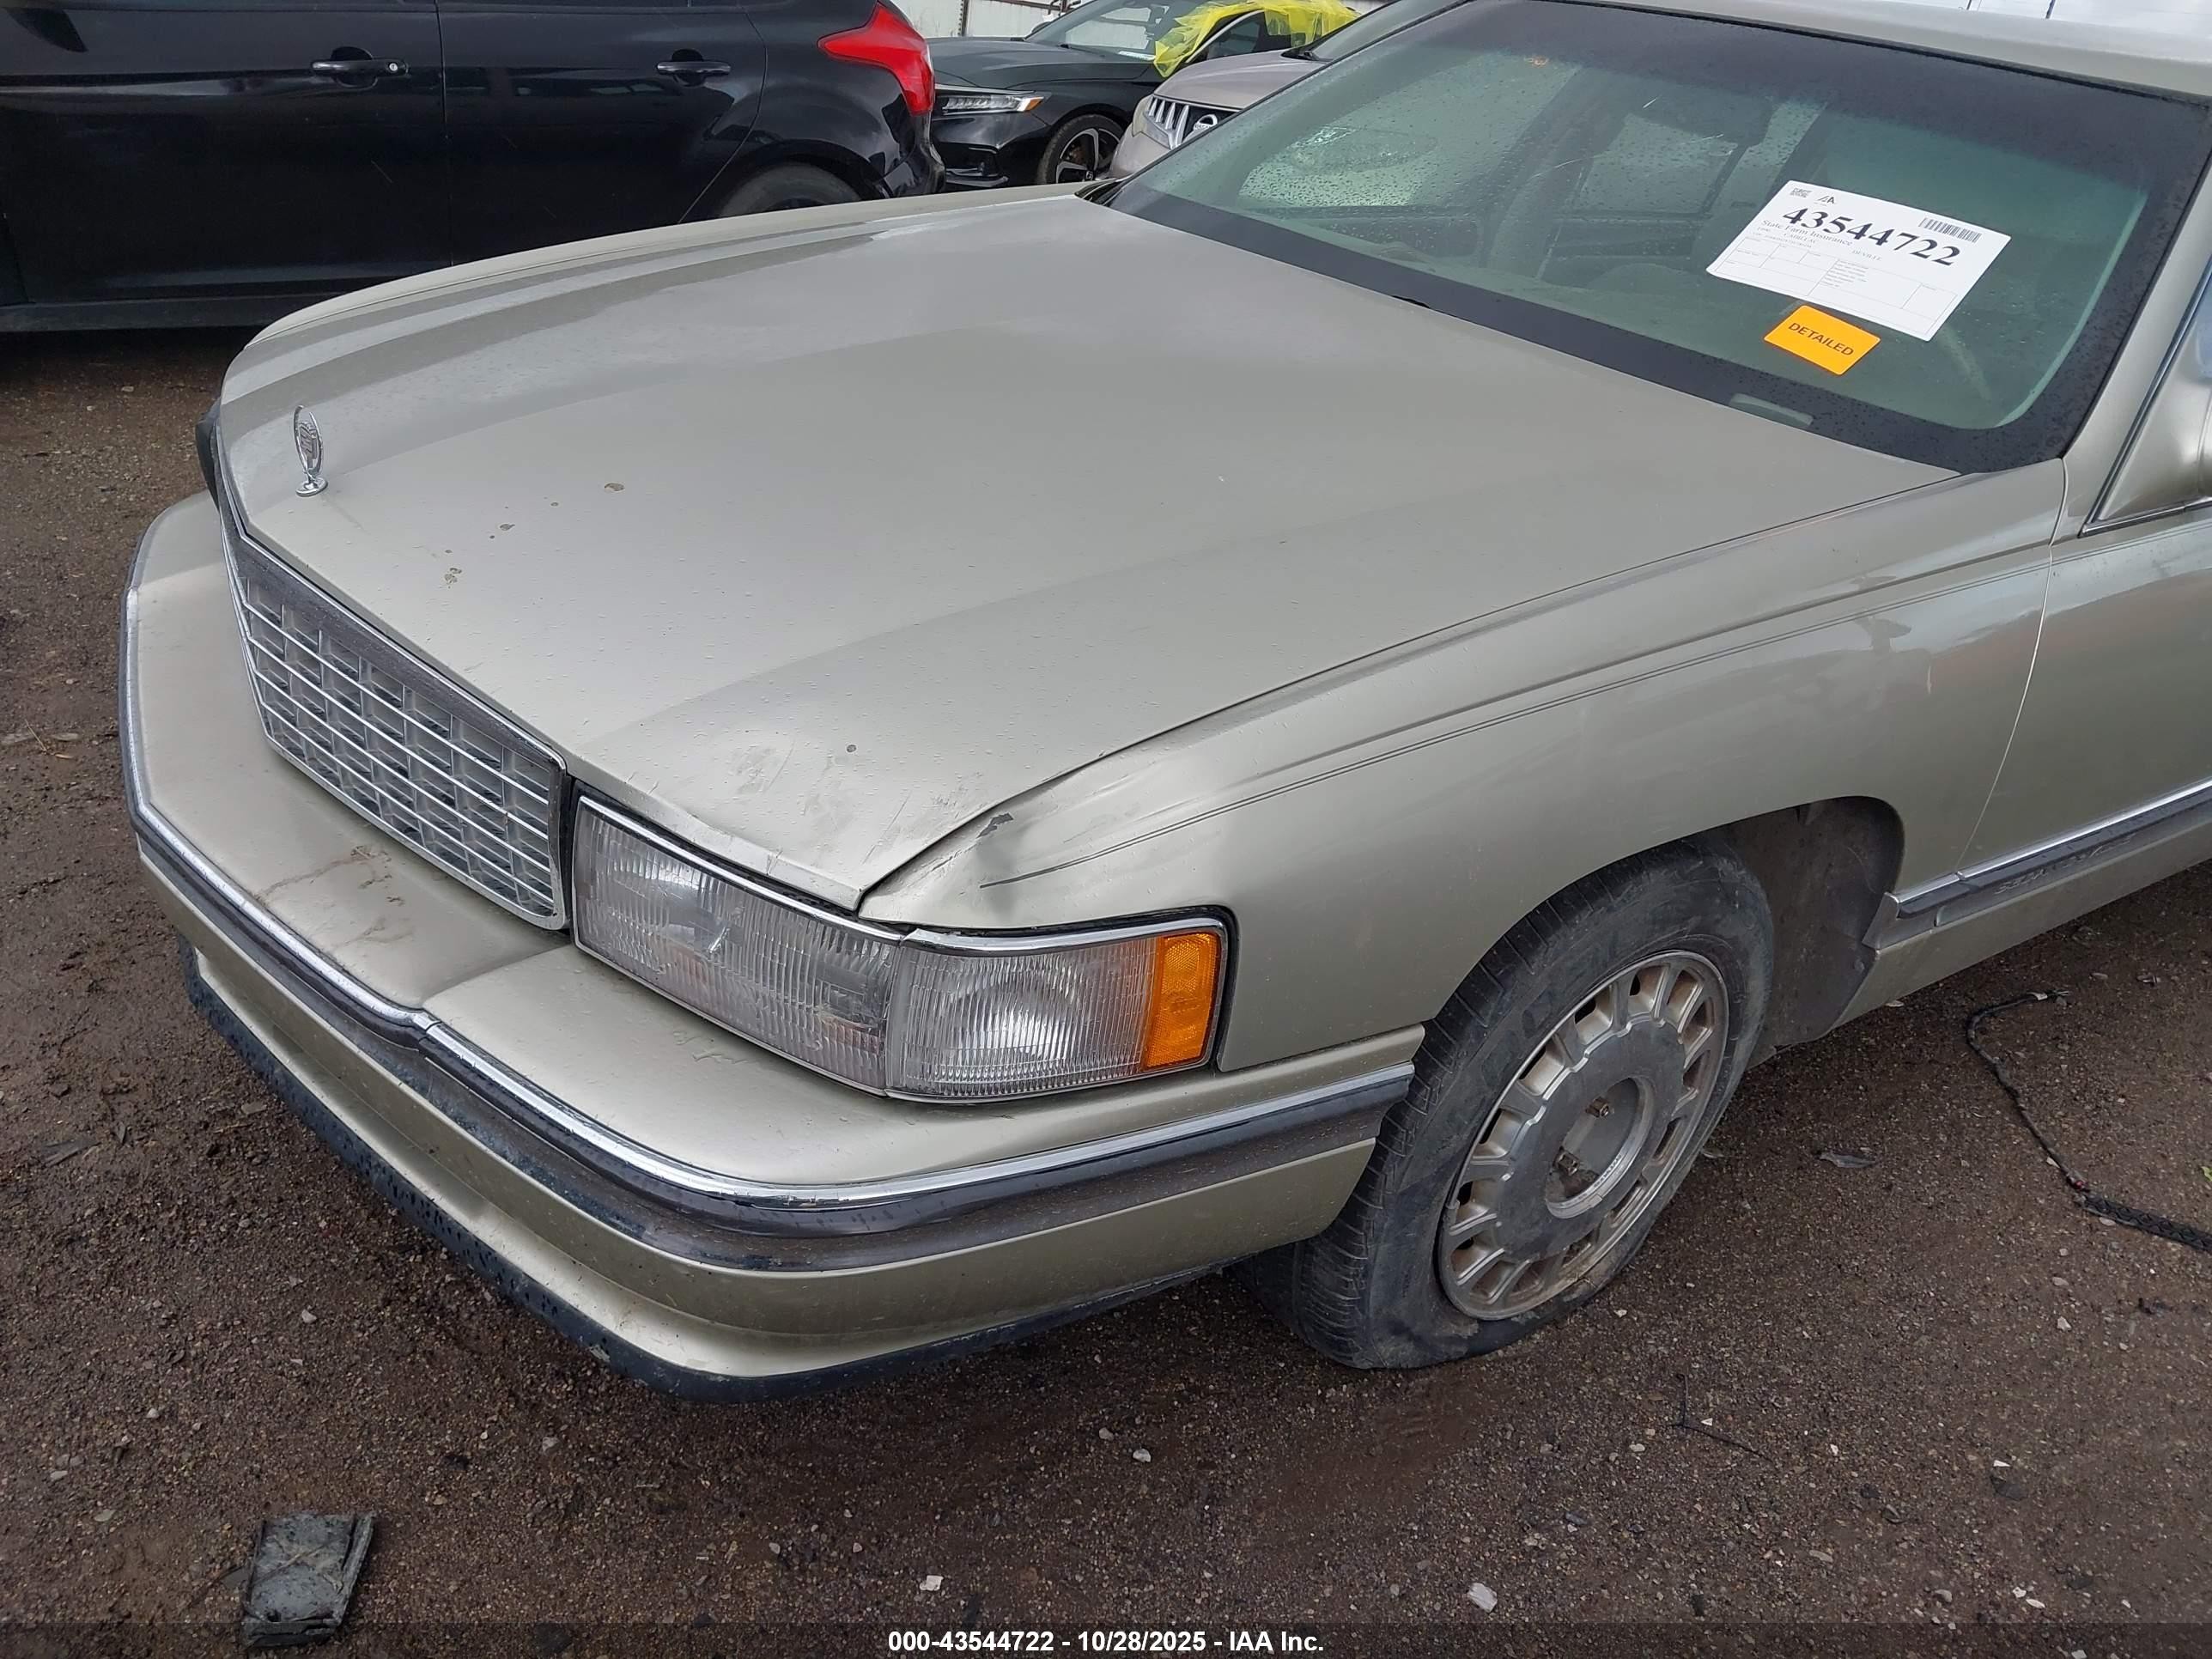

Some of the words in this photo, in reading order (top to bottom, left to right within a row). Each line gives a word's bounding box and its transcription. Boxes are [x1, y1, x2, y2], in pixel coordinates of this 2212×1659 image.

[1762, 220, 1783, 229] State
[1785, 225, 1808, 238] Farm
[1810, 230, 1853, 246] Insurance
[1783, 208, 1960, 266] 43544722
[1788, 322, 1854, 356] DETAILED
